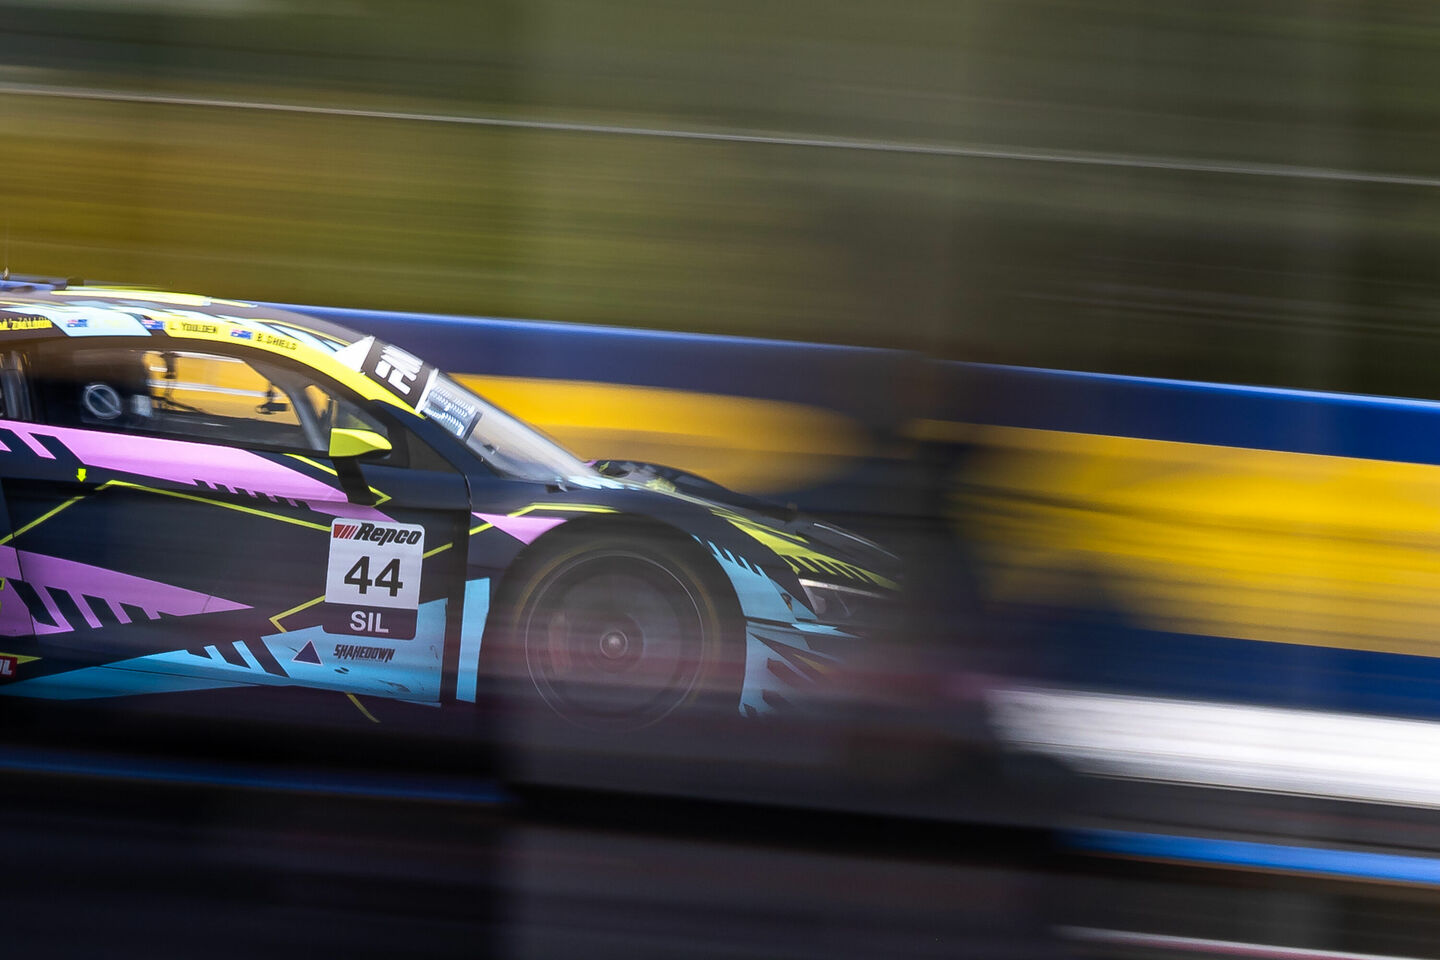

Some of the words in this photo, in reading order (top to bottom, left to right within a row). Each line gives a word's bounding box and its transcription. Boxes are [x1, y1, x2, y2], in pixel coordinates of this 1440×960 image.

[354, 522, 422, 546] Repco
[344, 555, 403, 597] 44
[349, 610, 389, 634] SIL
